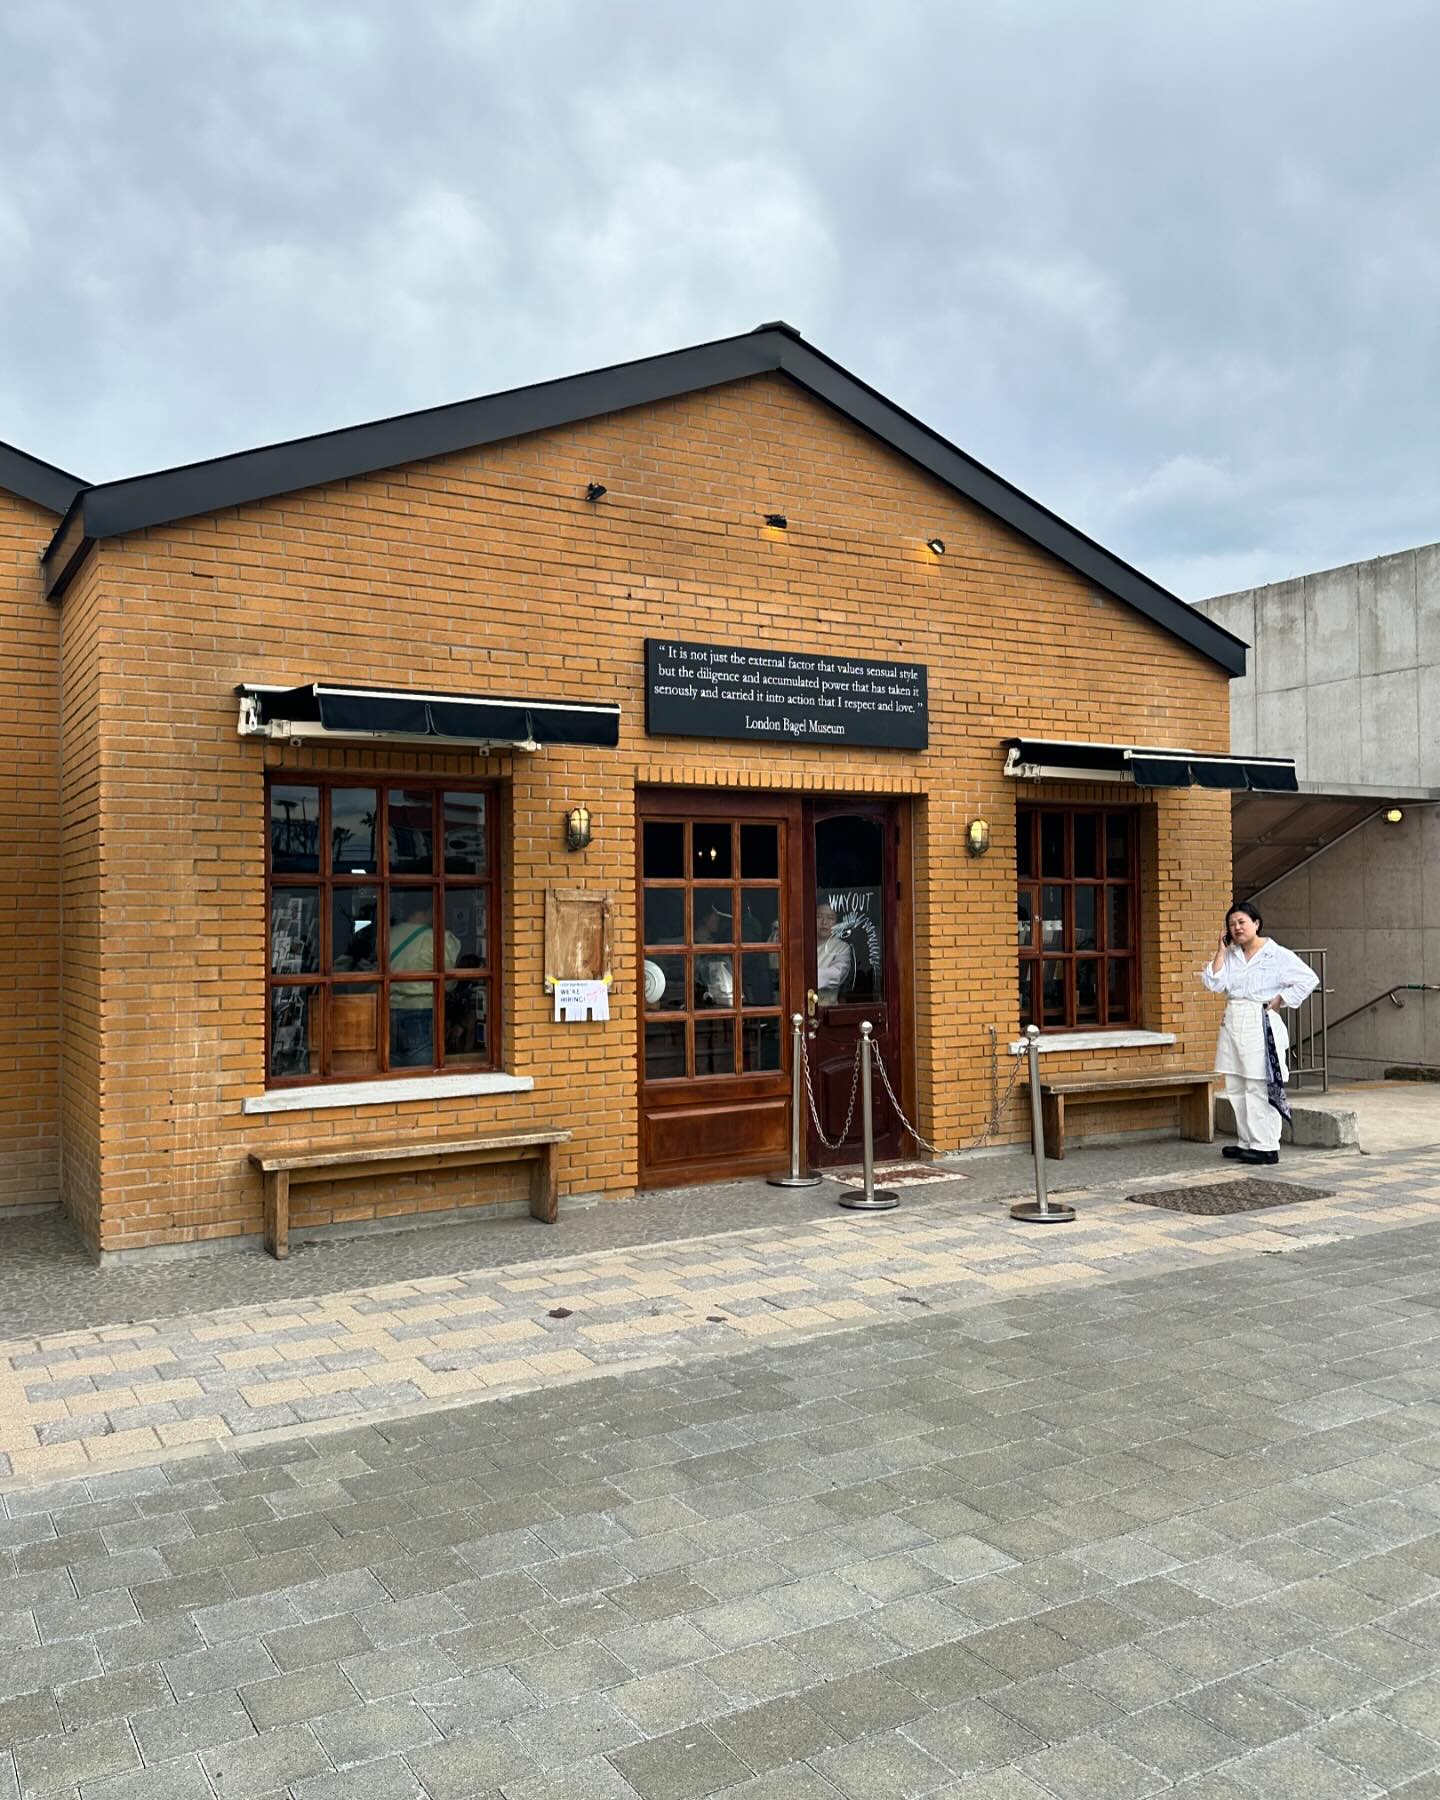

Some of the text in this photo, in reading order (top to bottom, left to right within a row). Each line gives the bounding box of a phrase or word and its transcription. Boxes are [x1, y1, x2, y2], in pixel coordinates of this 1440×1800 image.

[680, 646, 687, 659] is
[690, 651, 707, 661] not
[709, 650, 728, 665] just
[730, 652, 746, 665] the
[748, 656, 785, 668] external
[788, 656, 815, 671] factor
[817, 660, 835, 673] that
[837, 662, 864, 675] values
[866, 667, 897, 678] sensual
[899, 668, 918, 683] style
[658, 664, 919, 697] but the diligence and accumulated power that has taken it
[654, 684, 698, 700] seriously
[700, 686, 718, 698] and
[721, 689, 754, 701] carried
[756, 690, 764, 702] it
[766, 691, 785, 704] into
[787, 694, 815, 705] action
[818, 695, 835, 707] that
[837, 697, 842, 707] I
[844, 700, 875, 712] respect
[878, 700, 893, 711] and
[746, 715, 845, 736] London Bagel Museum
